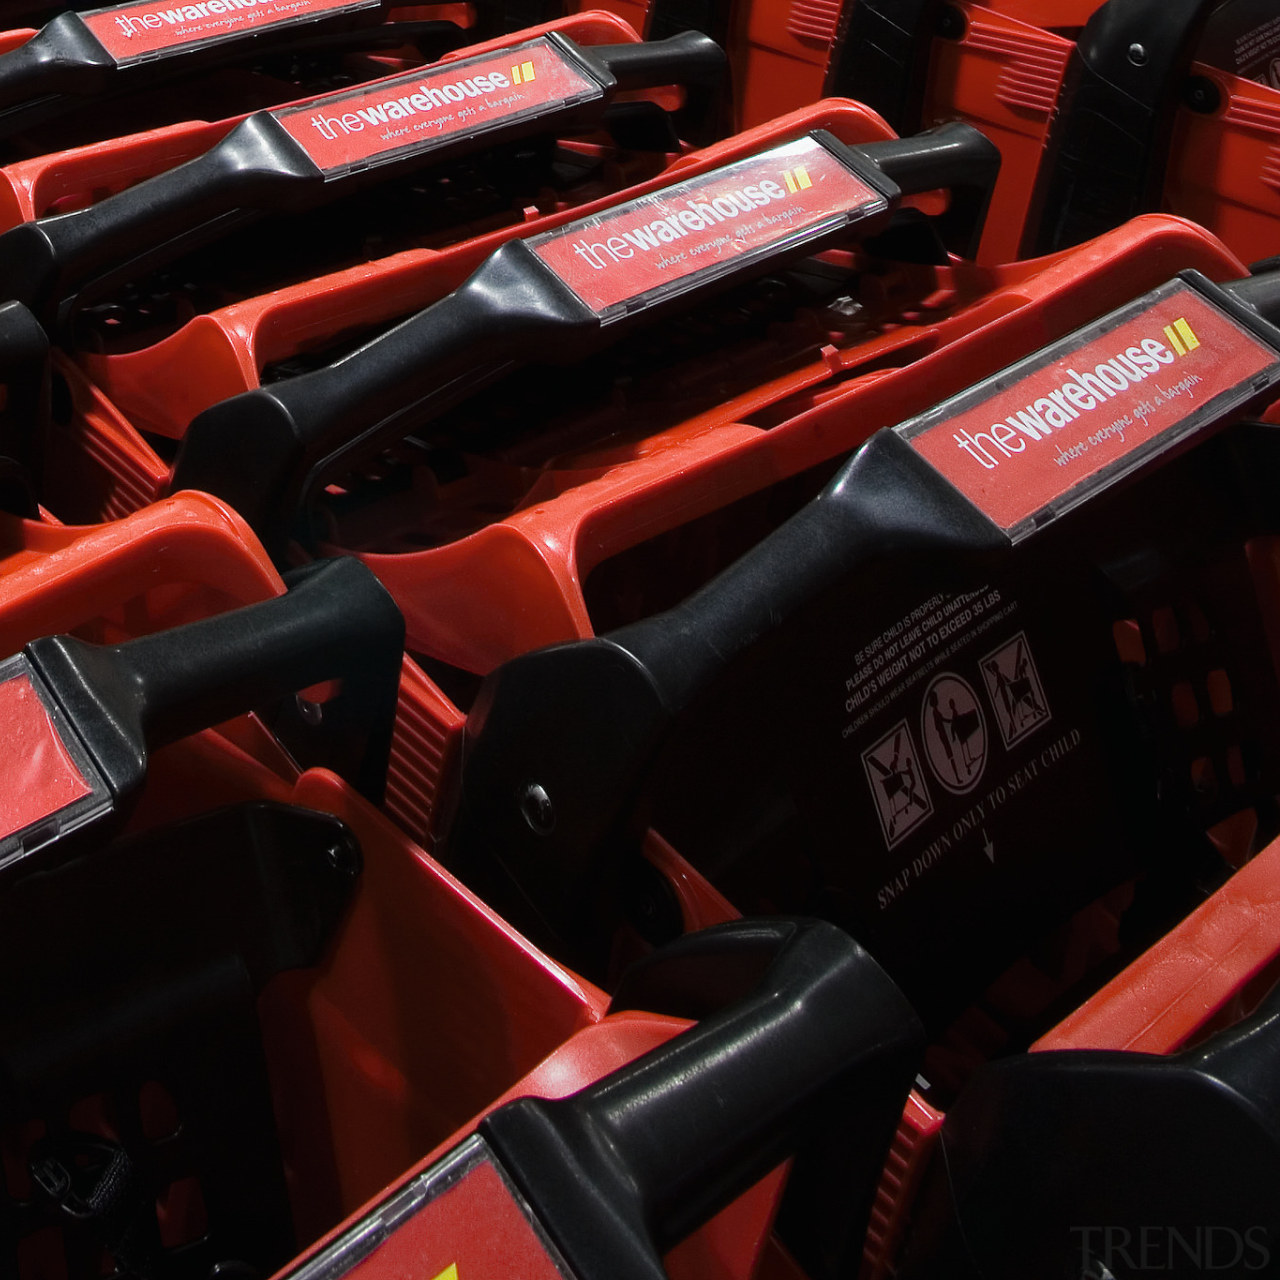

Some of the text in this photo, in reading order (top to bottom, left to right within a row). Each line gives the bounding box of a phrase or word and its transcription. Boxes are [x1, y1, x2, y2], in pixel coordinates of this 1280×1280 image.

[1053, 371, 1203, 469] where everyone gets a bargain
[877, 728, 1082, 910] SNAP DOWN ONLY TO SEAT CHILD
